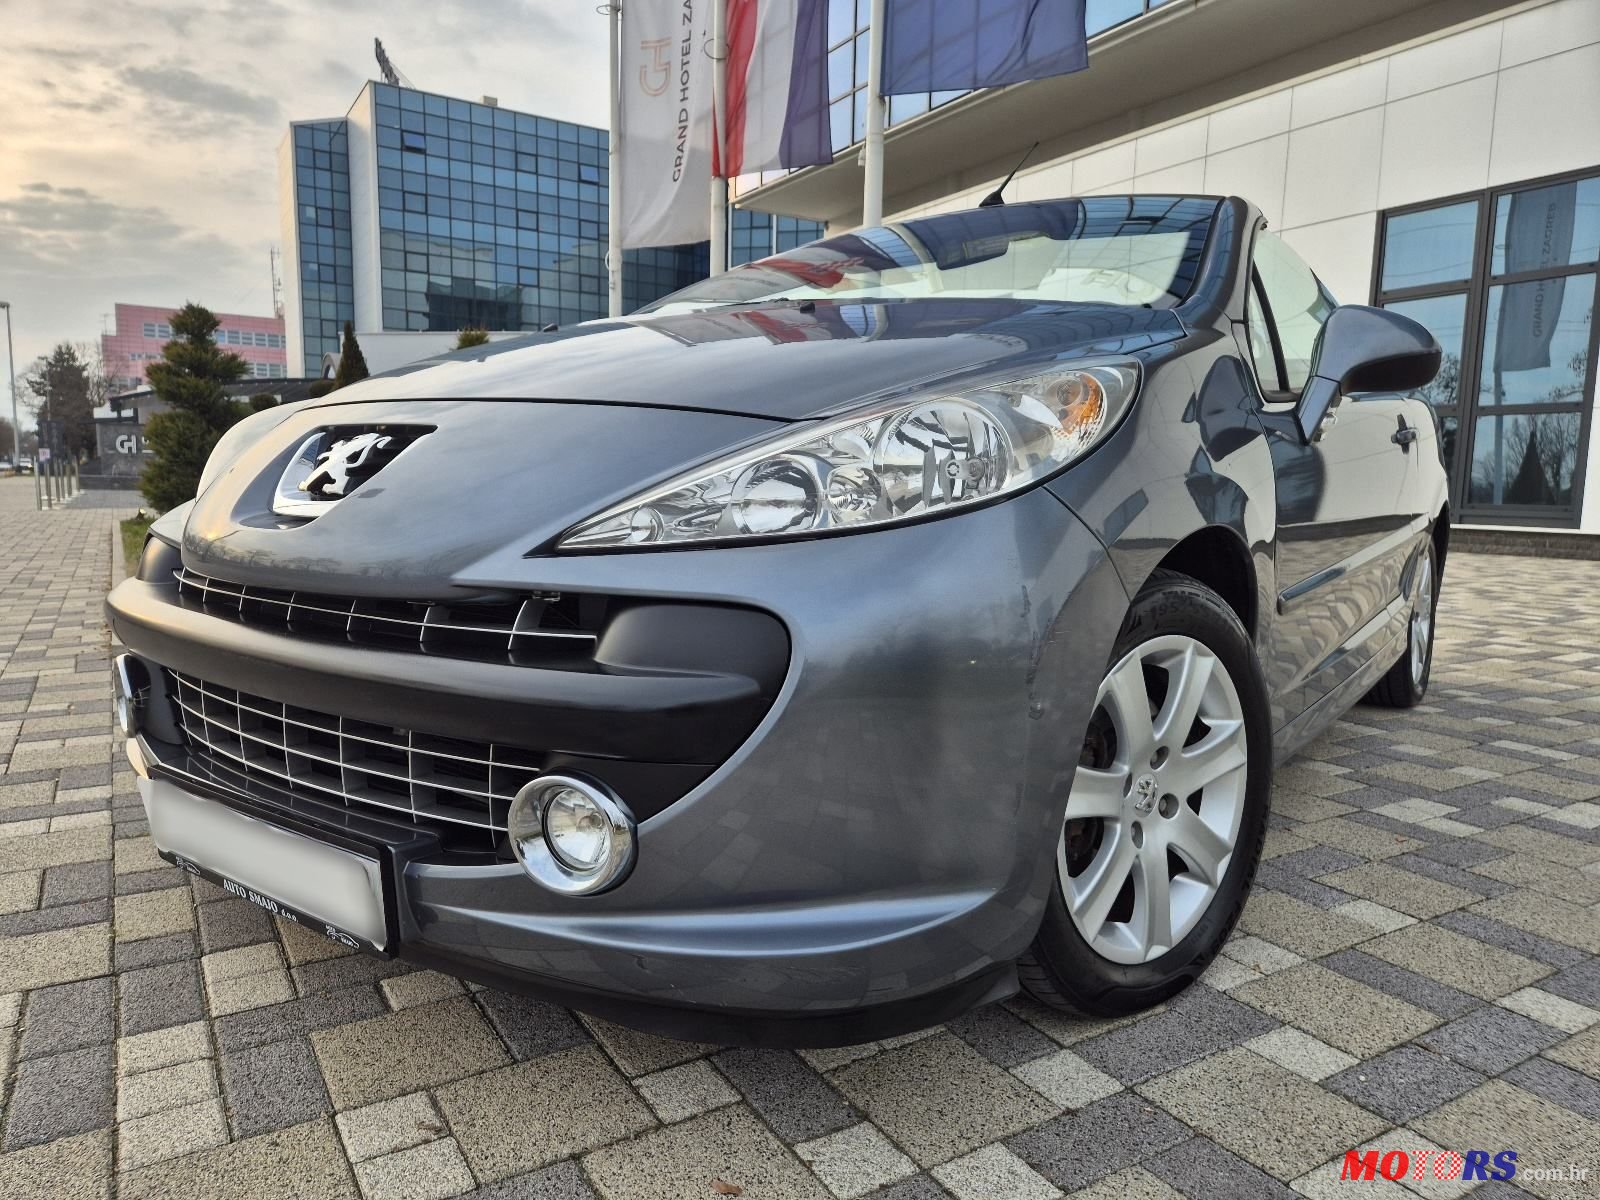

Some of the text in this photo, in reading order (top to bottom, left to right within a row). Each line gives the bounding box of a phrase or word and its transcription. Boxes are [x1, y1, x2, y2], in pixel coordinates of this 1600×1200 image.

[679, 30, 692, 102] HOTEL
[672, 108, 689, 183] GRAND
[1532, 293, 1544, 338] GRAND
[223, 879, 247, 898] AUTO
[249, 891, 278, 913] SMAJO
